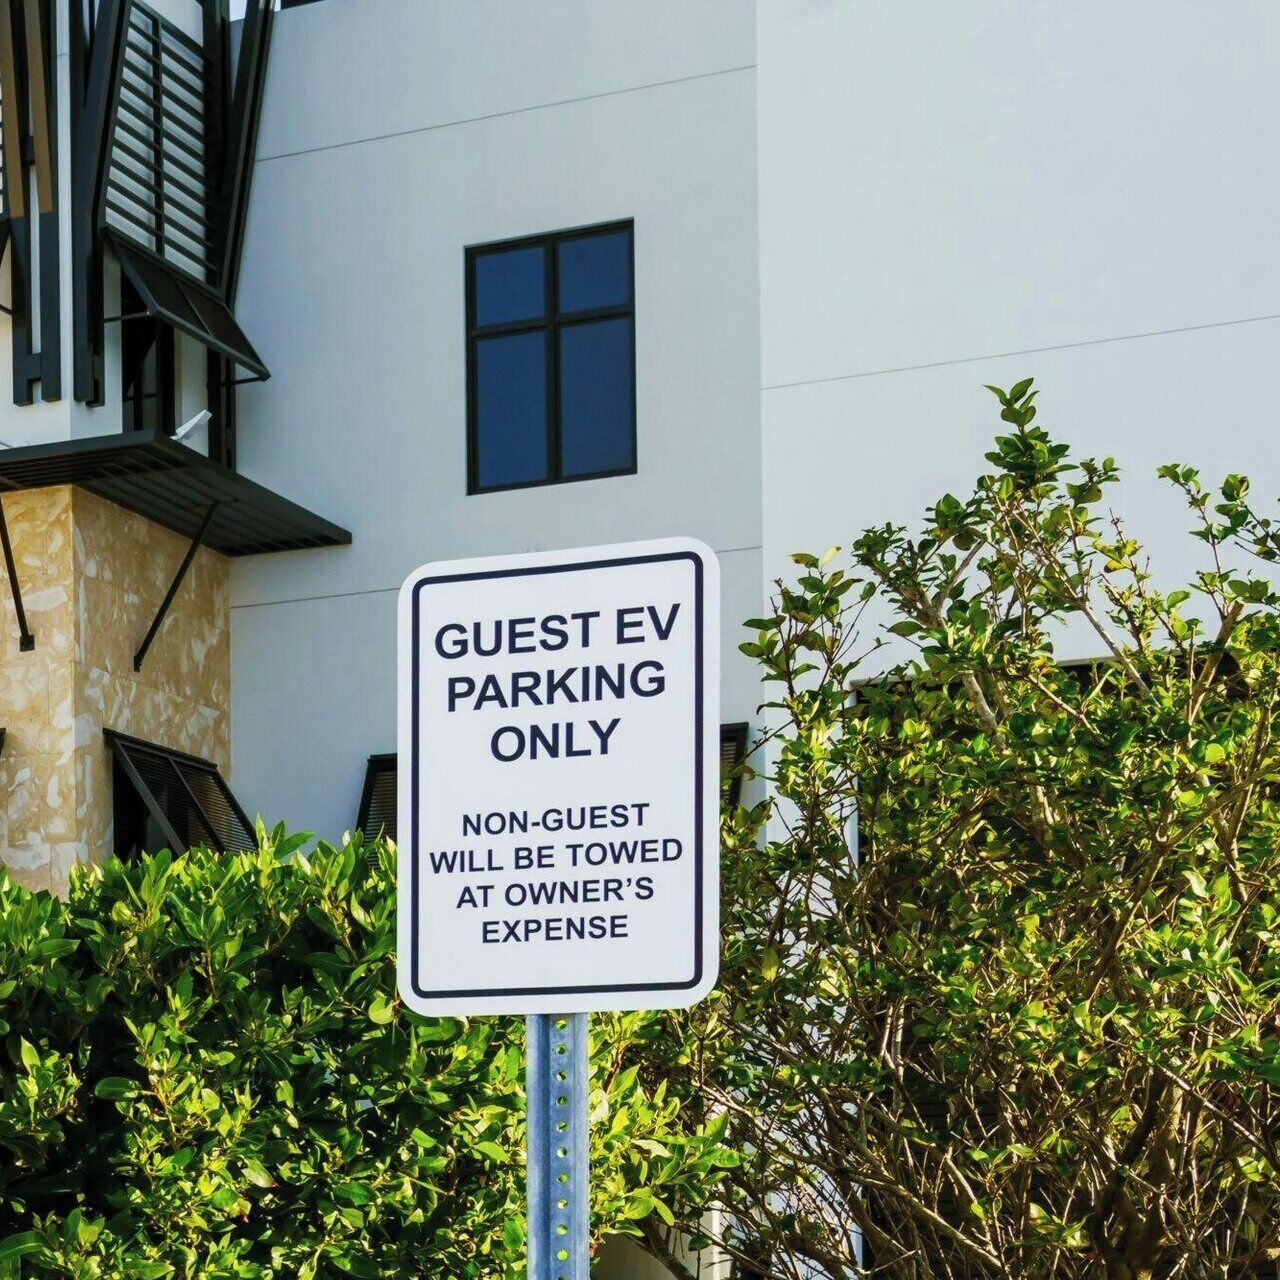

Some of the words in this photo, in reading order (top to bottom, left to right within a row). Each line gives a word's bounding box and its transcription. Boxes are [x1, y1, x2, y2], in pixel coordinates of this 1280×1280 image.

[434, 610, 600, 659] GUEST
[616, 602, 680, 644] EV
[445, 657, 665, 712] PARKING
[490, 717, 621, 762] ONLY
[462, 802, 649, 836] NON-GUEST
[429, 848, 503, 874] WILL
[514, 845, 554, 869] BE
[565, 838, 682, 866] TOWED
[456, 884, 492, 908] AT
[504, 876, 653, 906] OWNER’S
[482, 914, 628, 943] EXPENSE
